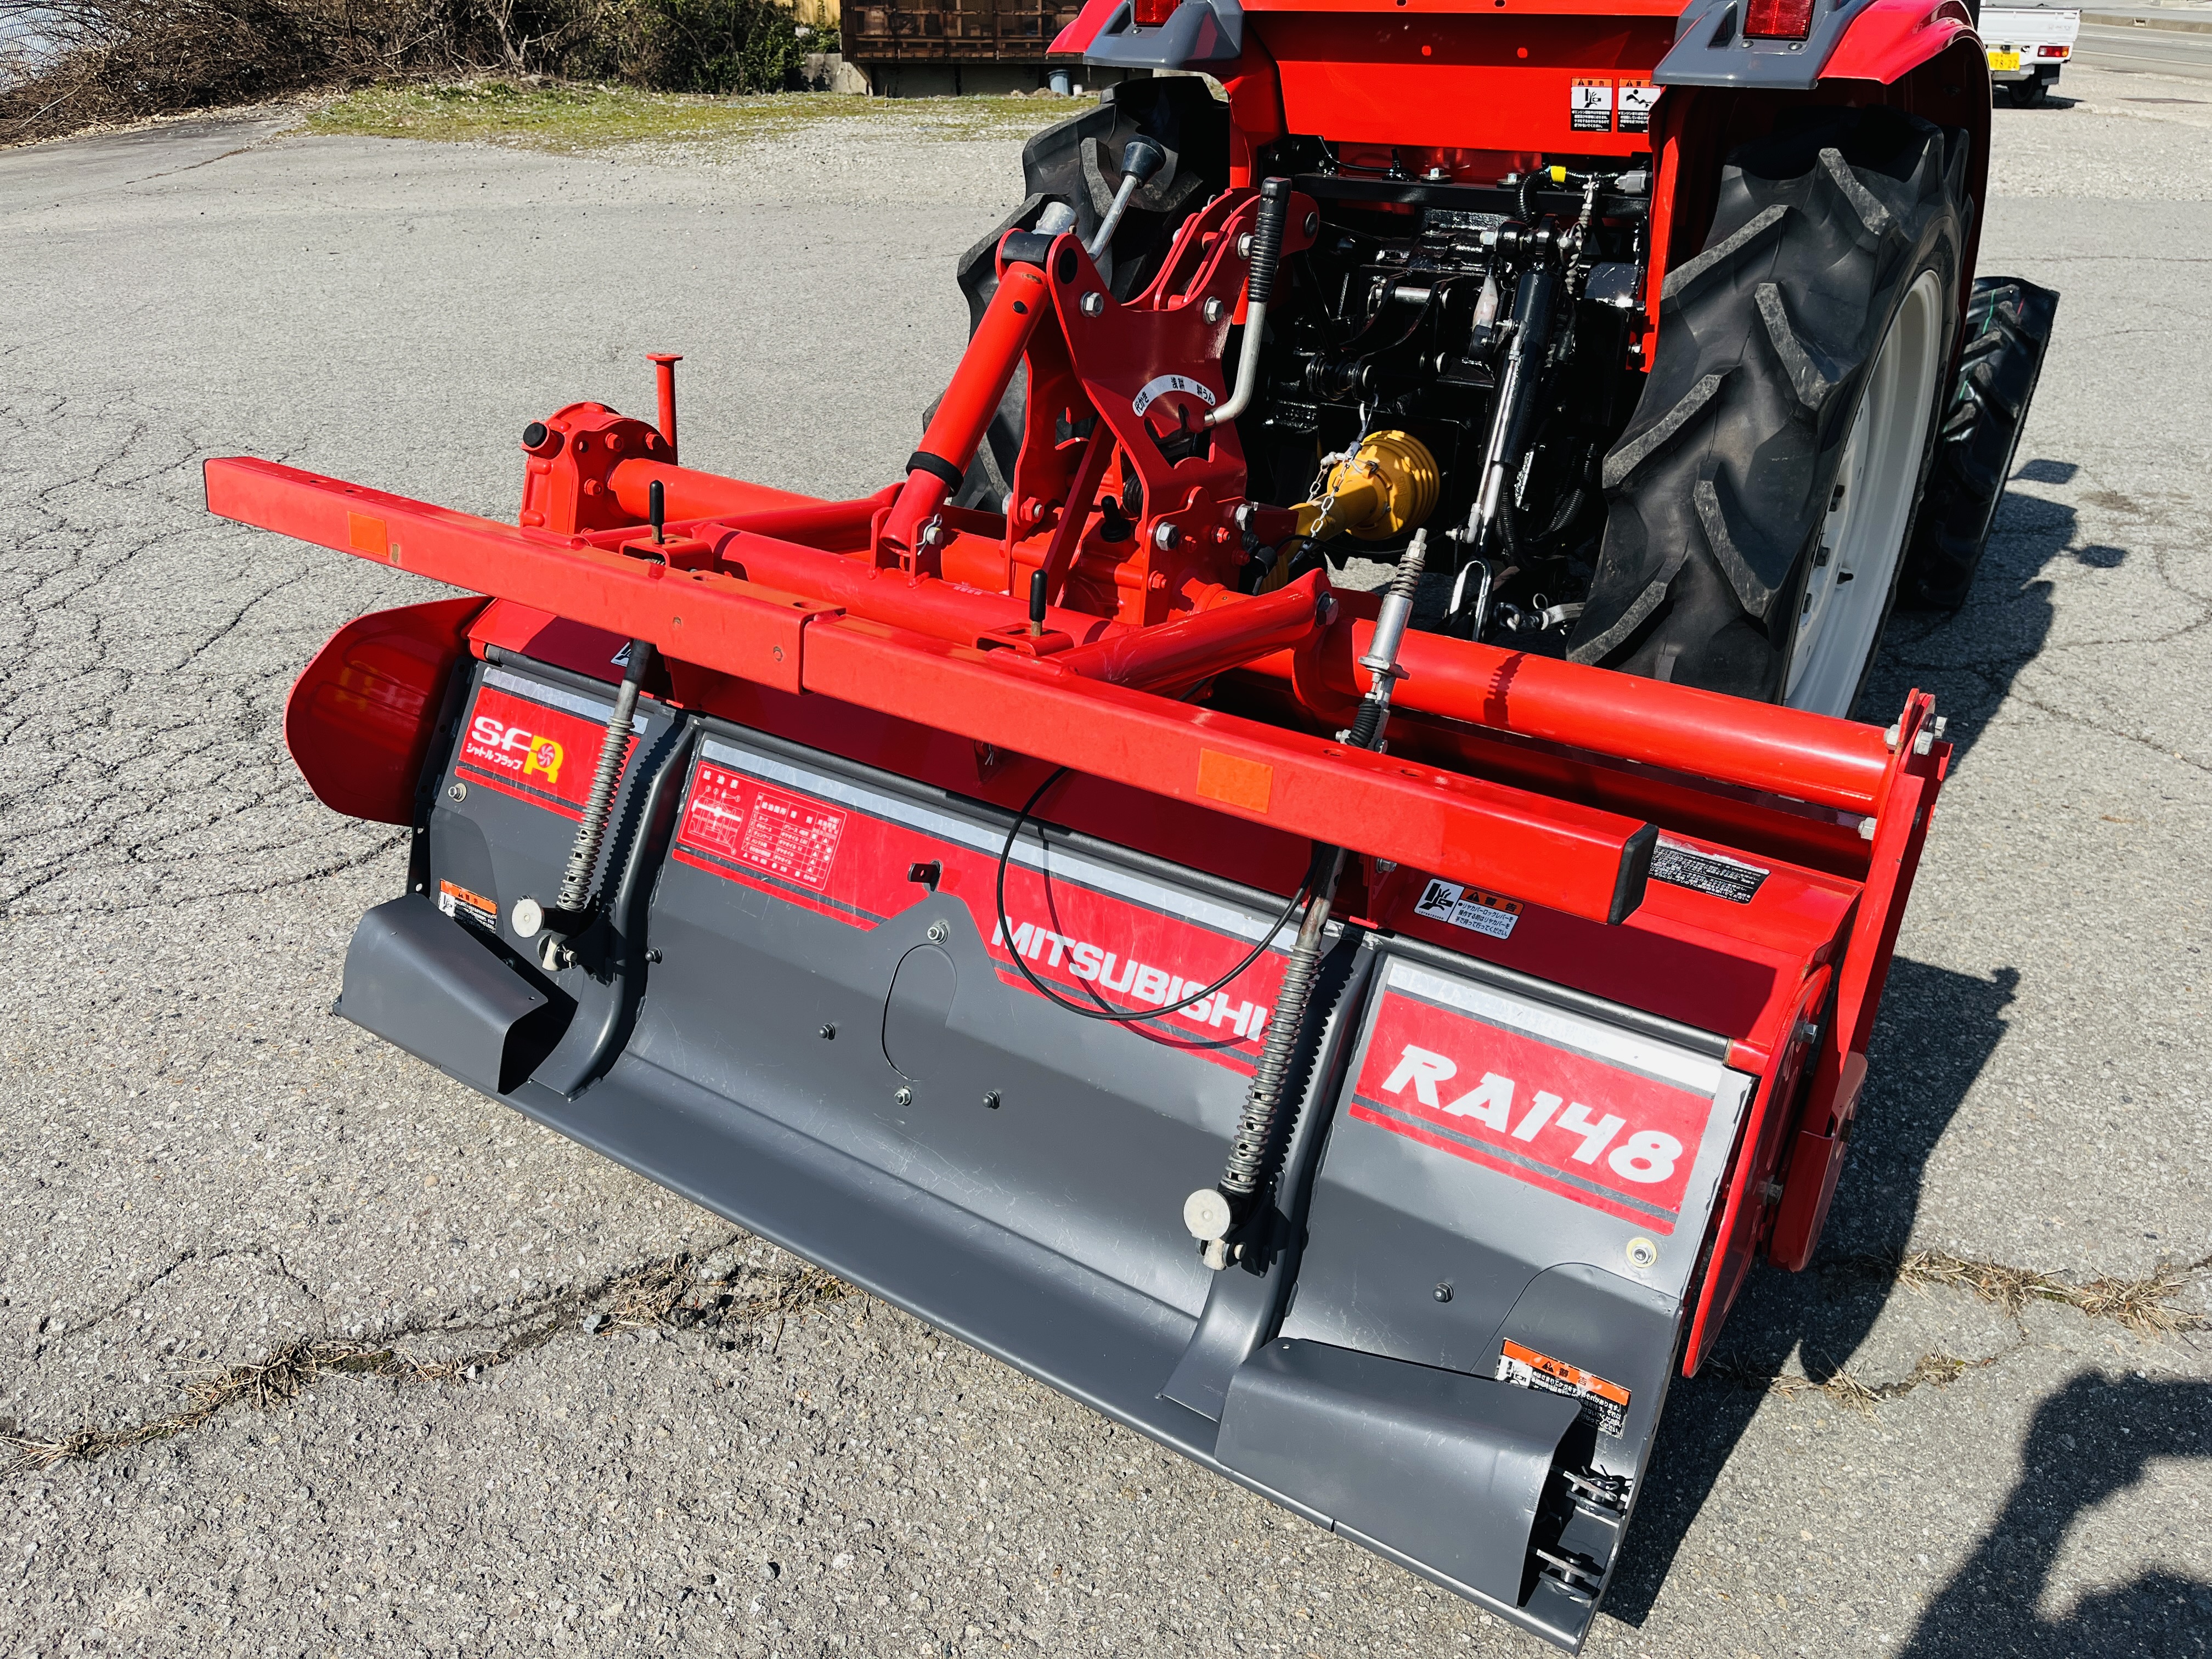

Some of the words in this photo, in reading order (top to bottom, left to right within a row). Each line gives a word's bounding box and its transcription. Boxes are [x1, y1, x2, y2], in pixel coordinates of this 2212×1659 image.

[1135, 392, 1149, 414] 代かき
[1197, 384, 1214, 404] 耕うん
[466, 743, 523, 770] シャトルフラップ
[1484, 896, 1517, 912] 警告
[990, 916, 1268, 1042] MITSUBISHI
[1381, 1045, 1683, 1183] RA148
